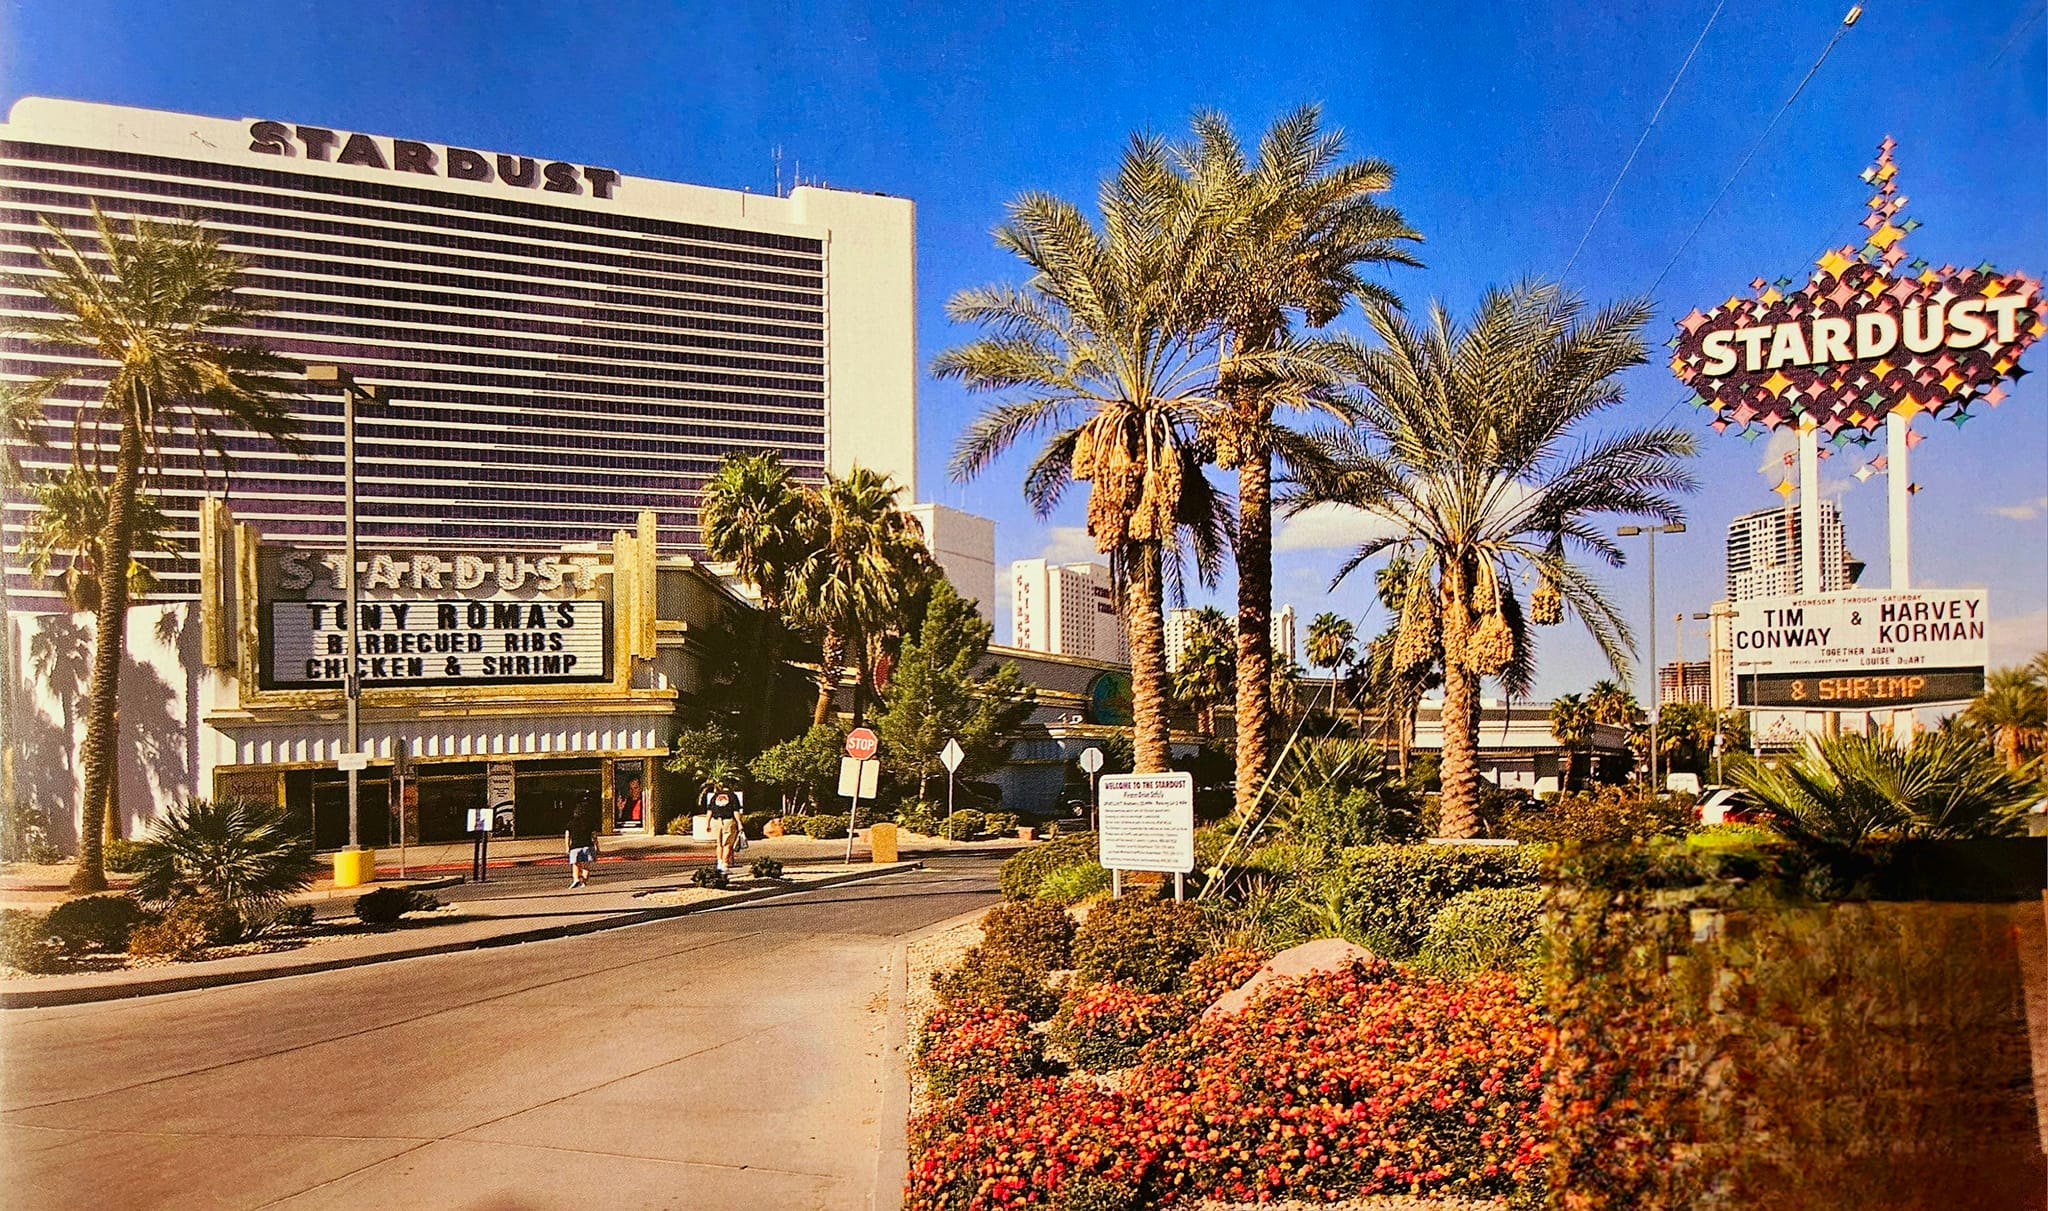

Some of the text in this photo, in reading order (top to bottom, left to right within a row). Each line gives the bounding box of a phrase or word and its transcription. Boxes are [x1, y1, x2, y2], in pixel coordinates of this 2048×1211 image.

[249, 121, 621, 199] STARDUST
[1701, 295, 2028, 376] STARDUST
[279, 551, 601, 591] STARDUST
[1792, 594, 1922, 607] WEDNESDAY THROUGH SATURDAY
[307, 602, 575, 630] TONY ROMA'S
[1764, 600, 1980, 628] TIM & HARVEY
[327, 632, 564, 655] BRBECUED RIBS
[1737, 621, 1984, 650] CONWAY KORMAN
[1821, 647, 1895, 656] TOGETHER AGAIN
[1860, 656, 1890, 666] LOUISE
[445, 656, 463, 677] &
[482, 654, 578, 676] SHRIMP
[1791, 676, 1925, 701] & SHRIMP
[848, 738, 875, 750] STOP
[1105, 782, 1131, 790] WELCOME
[1143, 781, 1153, 789] THE
[1155, 780, 1186, 789] STARDUST
